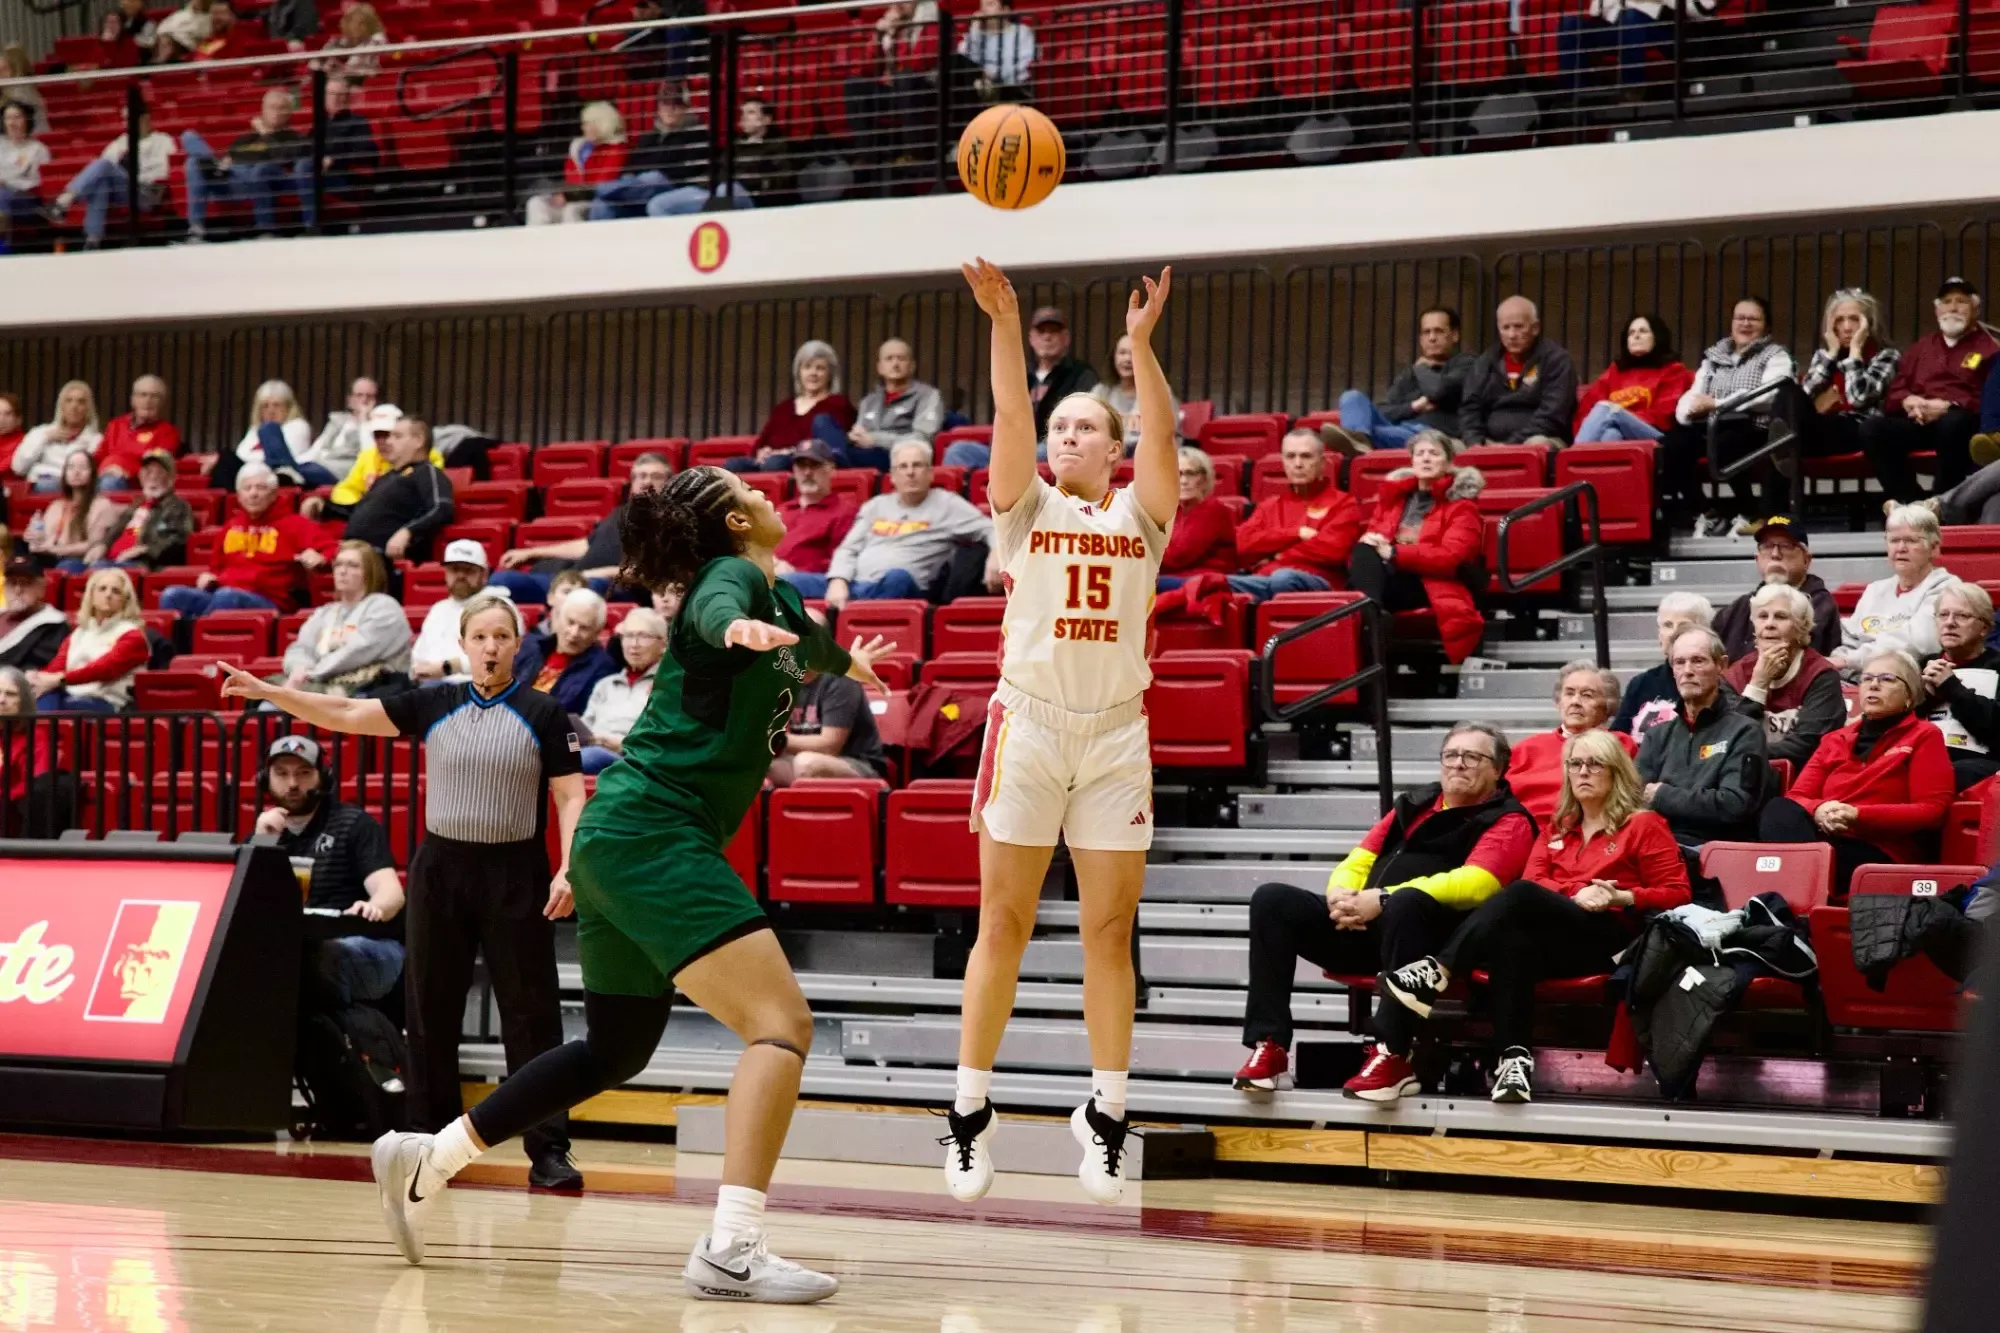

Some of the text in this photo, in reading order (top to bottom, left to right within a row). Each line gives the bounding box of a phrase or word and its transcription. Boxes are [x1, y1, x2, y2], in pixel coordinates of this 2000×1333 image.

[699, 227, 720, 268] B
[1029, 530, 1146, 560] PITTSBURG
[1064, 563, 1112, 612] 15
[1053, 616, 1119, 643] STATE
[1760, 858, 1776, 870] 38
[1916, 881, 1933, 894] 39
